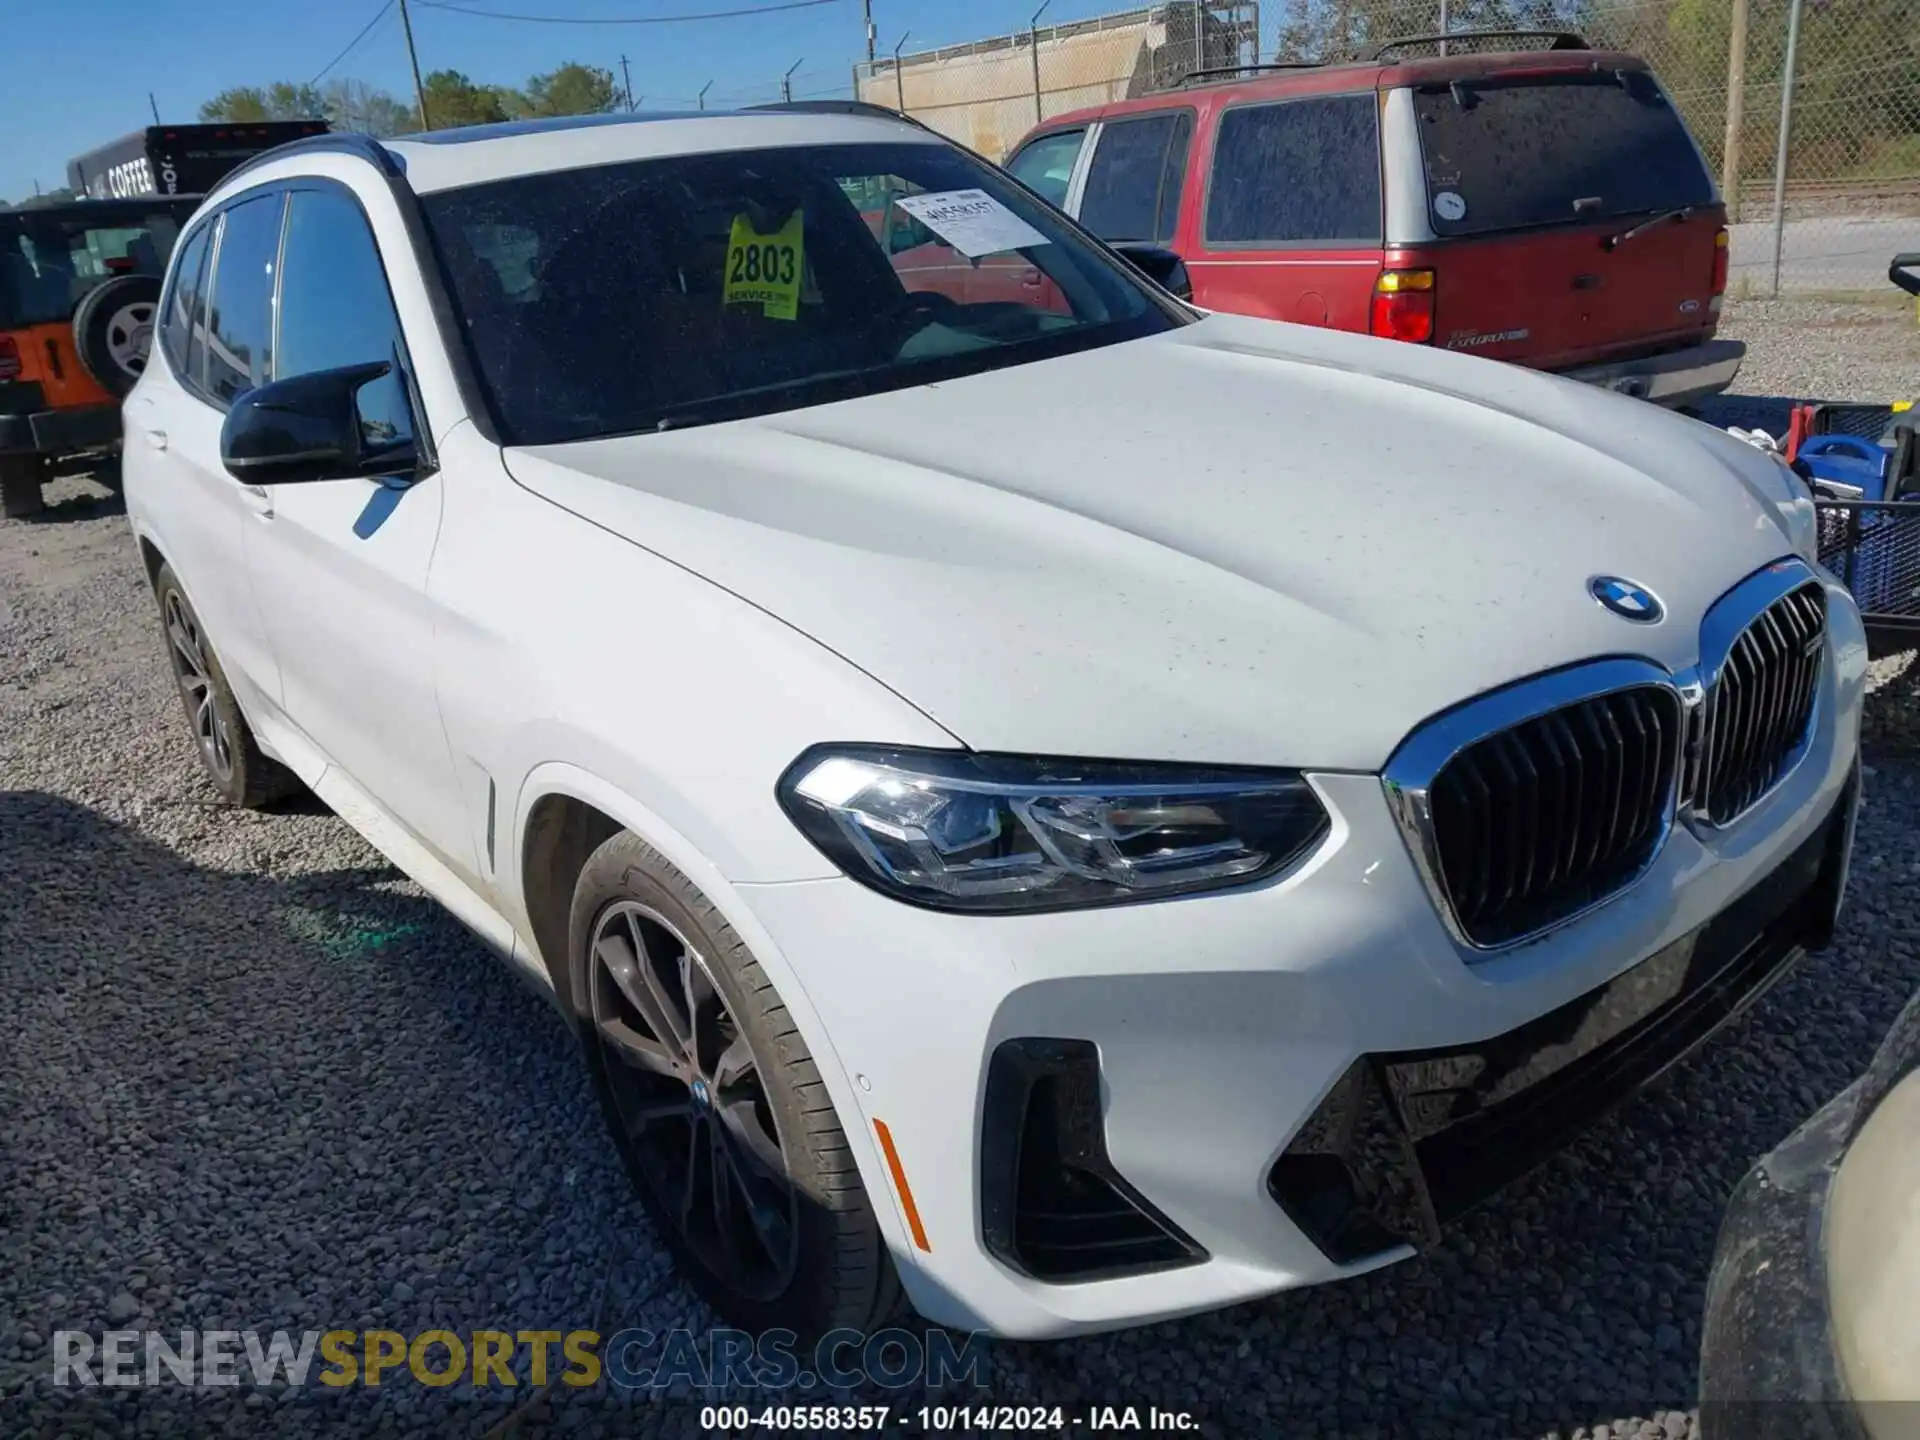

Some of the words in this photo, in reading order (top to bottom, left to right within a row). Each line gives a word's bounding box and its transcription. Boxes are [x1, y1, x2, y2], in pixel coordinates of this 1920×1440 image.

[108, 157, 152, 199] COFFEE
[730, 243, 795, 285] 2803
[728, 289, 775, 301] SERVICE
